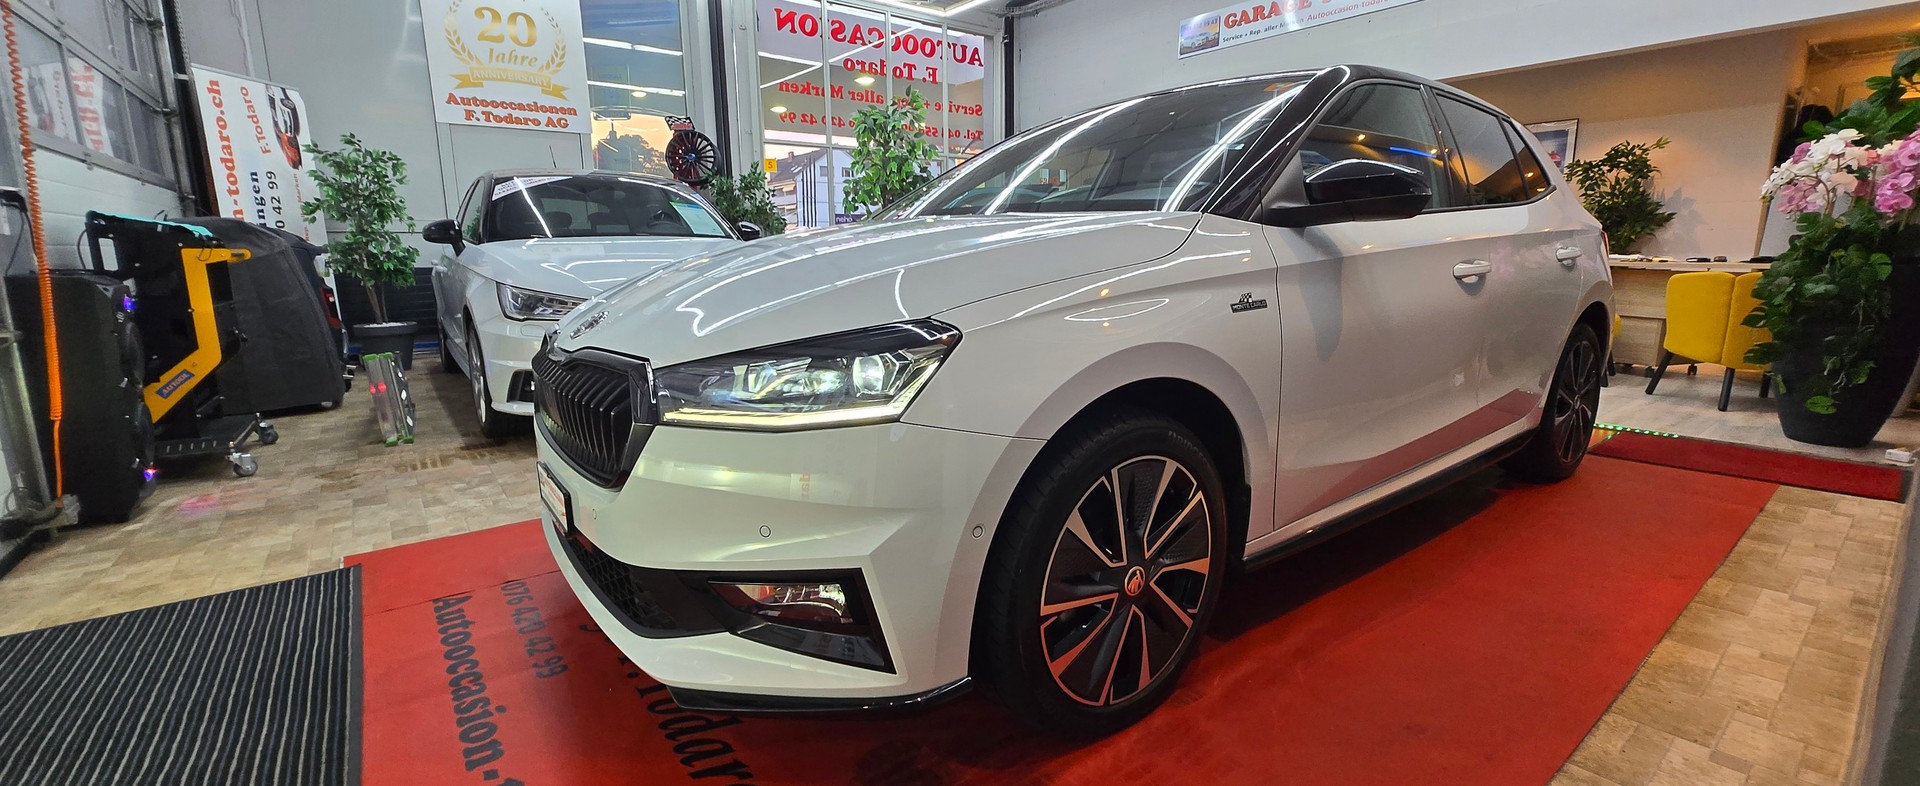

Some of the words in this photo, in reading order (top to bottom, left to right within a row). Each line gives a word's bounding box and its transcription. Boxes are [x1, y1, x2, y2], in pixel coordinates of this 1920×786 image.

[474, 6, 537, 47] 20
[1222, 32, 1243, 43] Service
[1264, 23, 1278, 32] aller
[487, 47, 538, 67] Jahre
[473, 69, 549, 87] ANNIVERSARY
[445, 92, 578, 117] Autooccasionen
[464, 109, 480, 122] F.
[481, 110, 542, 127] Todaro
[544, 117, 570, 129] AG
[767, 161, 773, 169] 5
[266, 170, 279, 194] 99
[270, 195, 283, 215] 42
[1232, 302, 1250, 311] MONTE
[1250, 300, 1267, 308] CARLO
[500, 581, 534, 605] 076
[512, 606, 546, 635] 420
[524, 635, 557, 658] 42
[532, 654, 569, 679] 99
[431, 595, 525, 786] Autooccasion-
